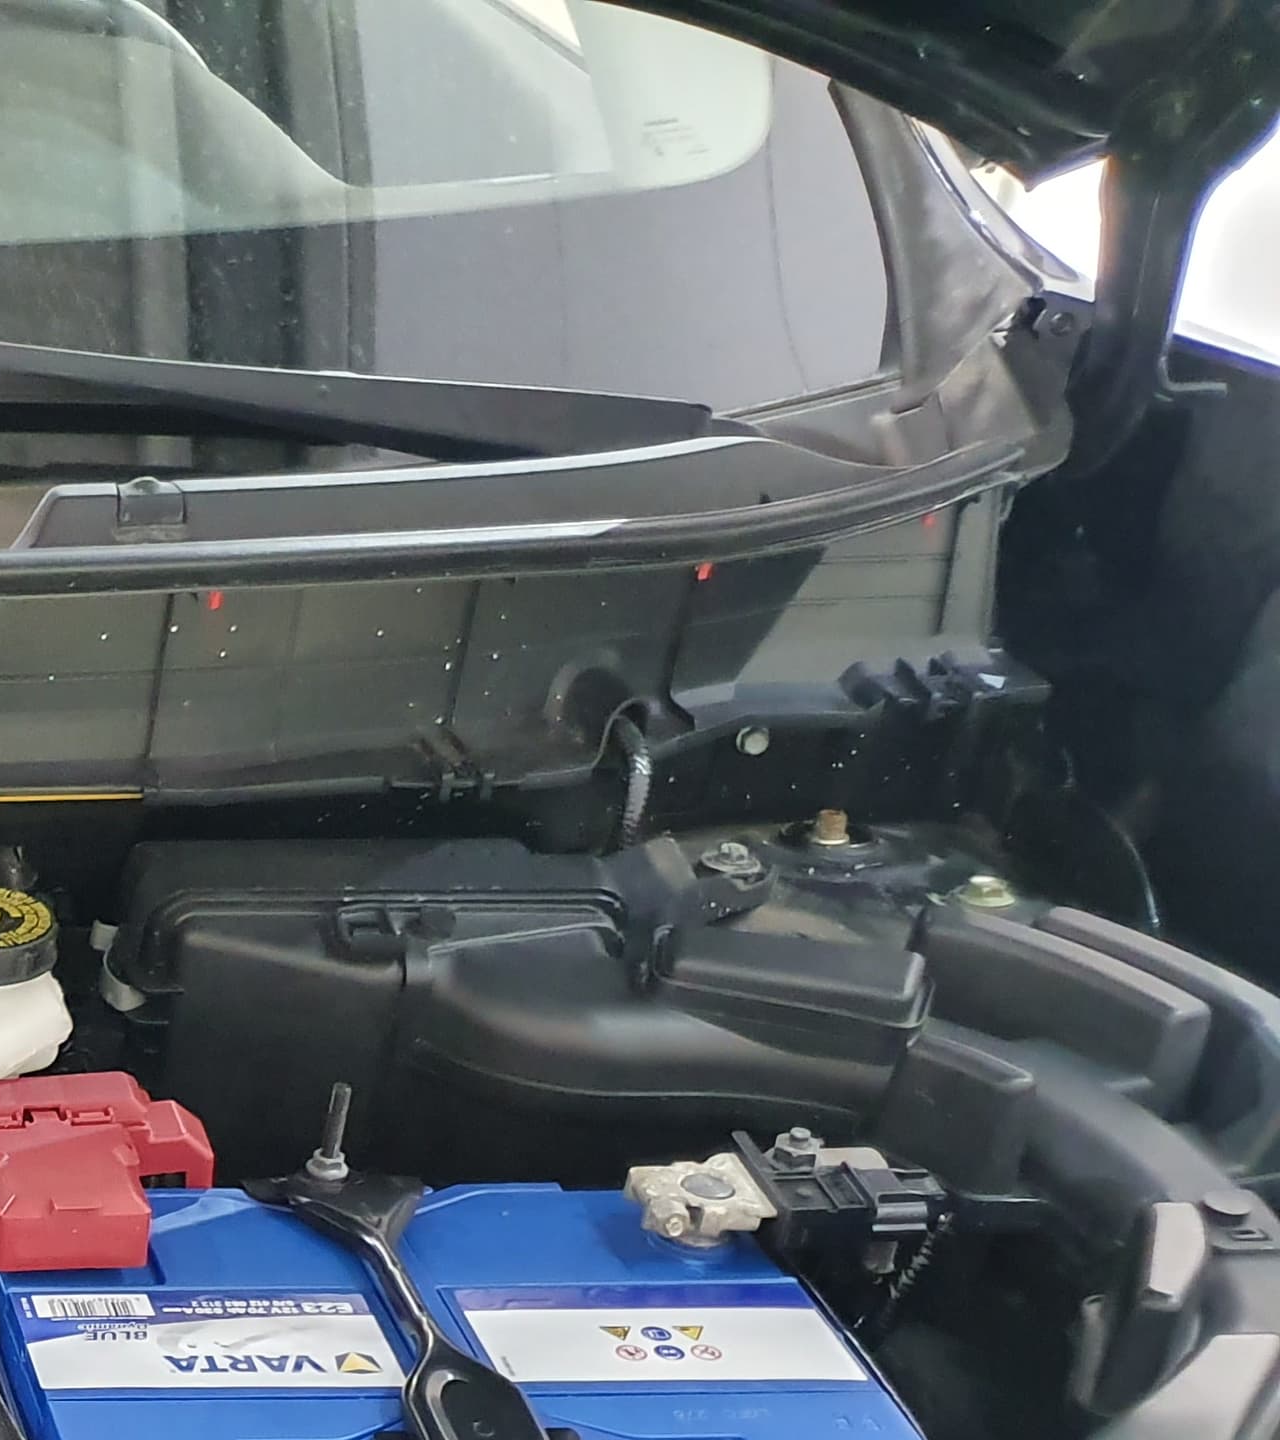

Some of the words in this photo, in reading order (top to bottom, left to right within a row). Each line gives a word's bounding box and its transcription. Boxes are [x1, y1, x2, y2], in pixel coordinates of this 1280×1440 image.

[302, 1302, 353, 1314] E23
[85, 1331, 148, 1341] BLUE
[164, 1355, 328, 1373] VARTA
